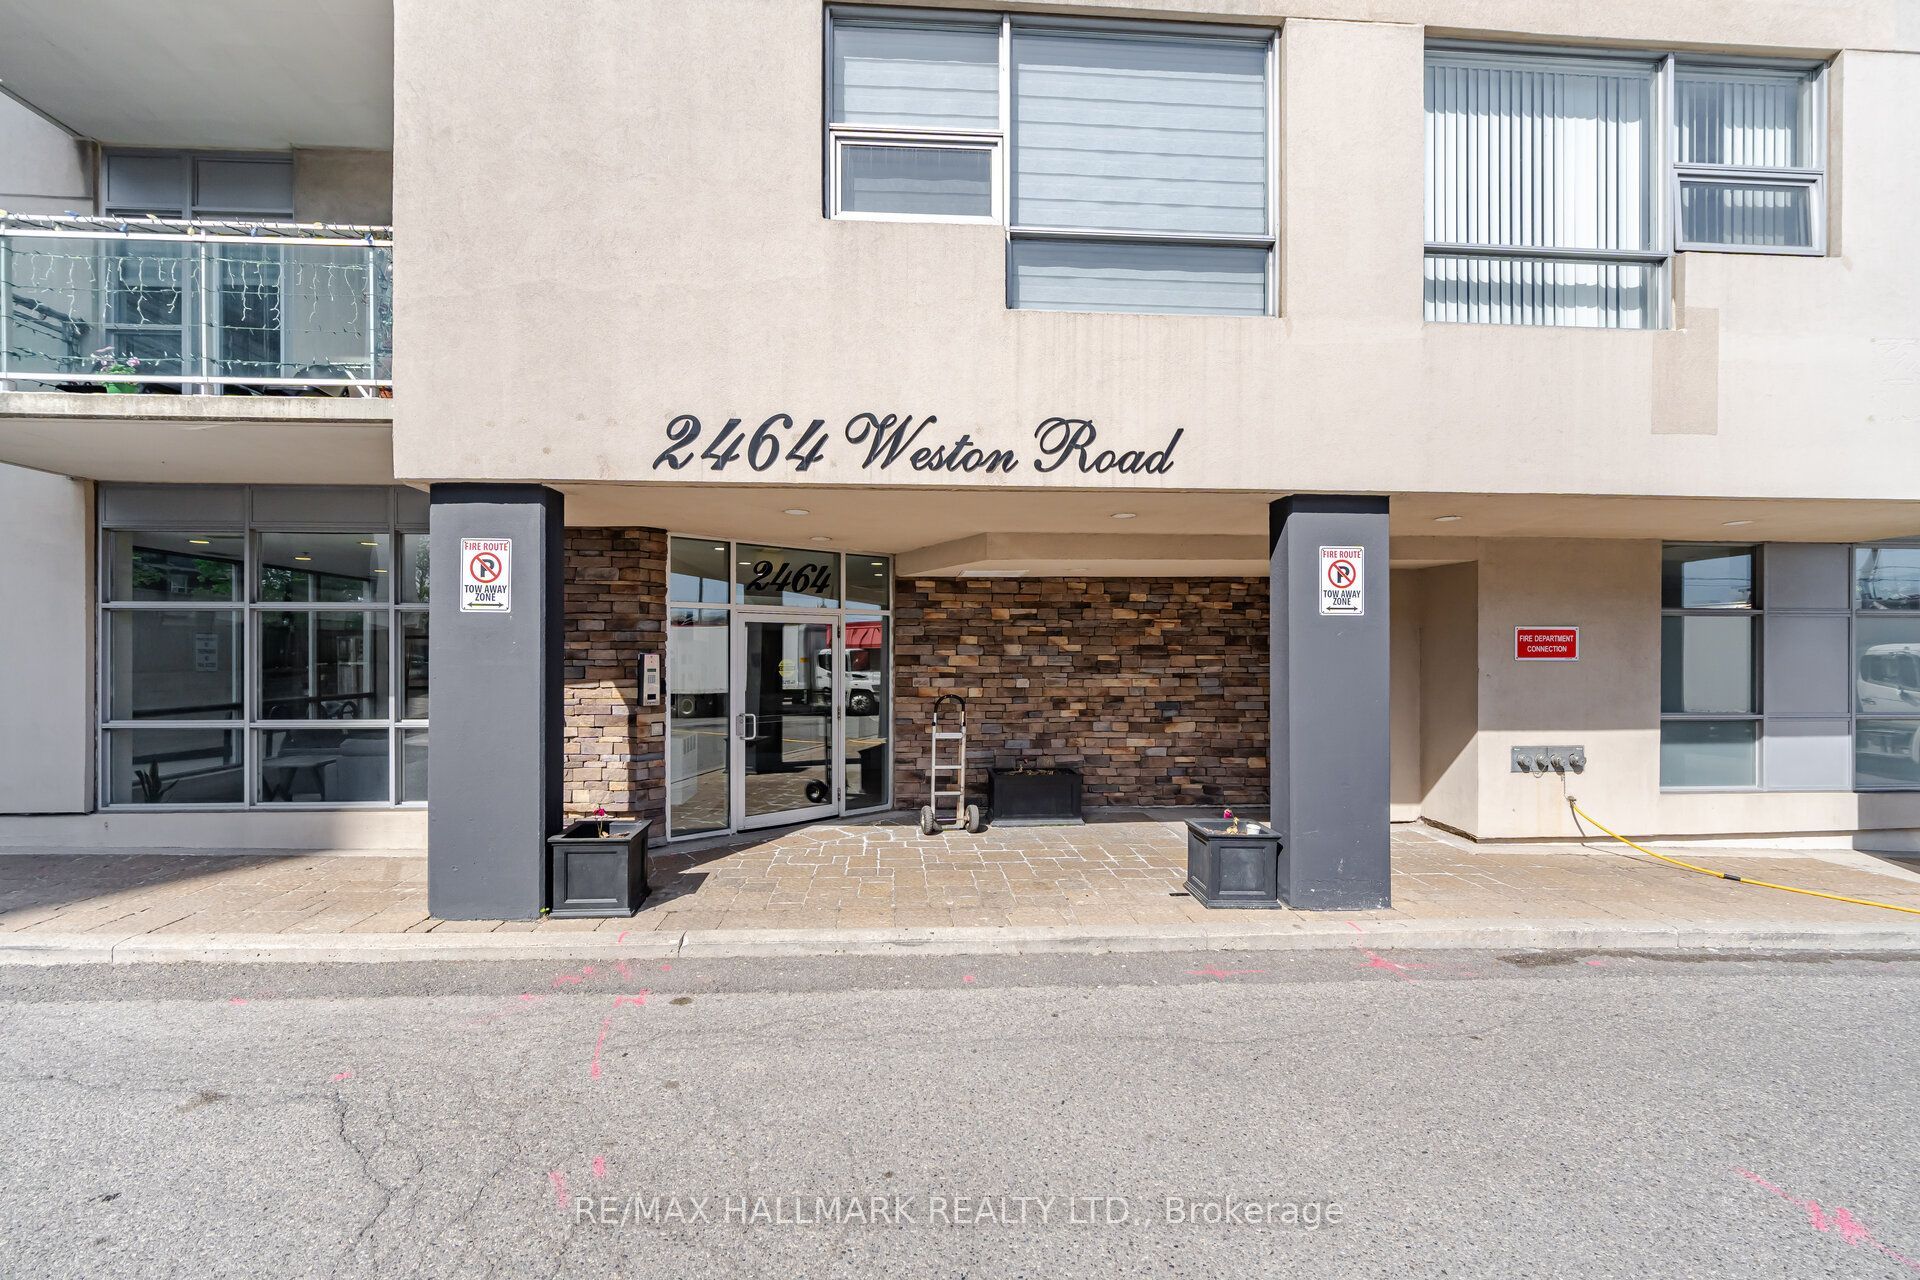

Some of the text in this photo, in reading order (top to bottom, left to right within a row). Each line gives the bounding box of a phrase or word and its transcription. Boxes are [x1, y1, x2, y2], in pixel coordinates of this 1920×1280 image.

[652, 412, 1185, 475] 2464 Weston Road
[464, 542, 508, 551] FIRE ROUTE
[1323, 550, 1361, 558] FIRE ROUTE
[745, 560, 832, 594] 2464
[464, 584, 507, 593] TOW AWAY
[475, 592, 496, 601] ZONE
[1323, 590, 1361, 598] TOW AWAY
[1332, 597, 1352, 606] ZONE
[1519, 634, 1574, 642] FIRE DEPARTMENT
[1526, 645, 1568, 653] CONNECTION
